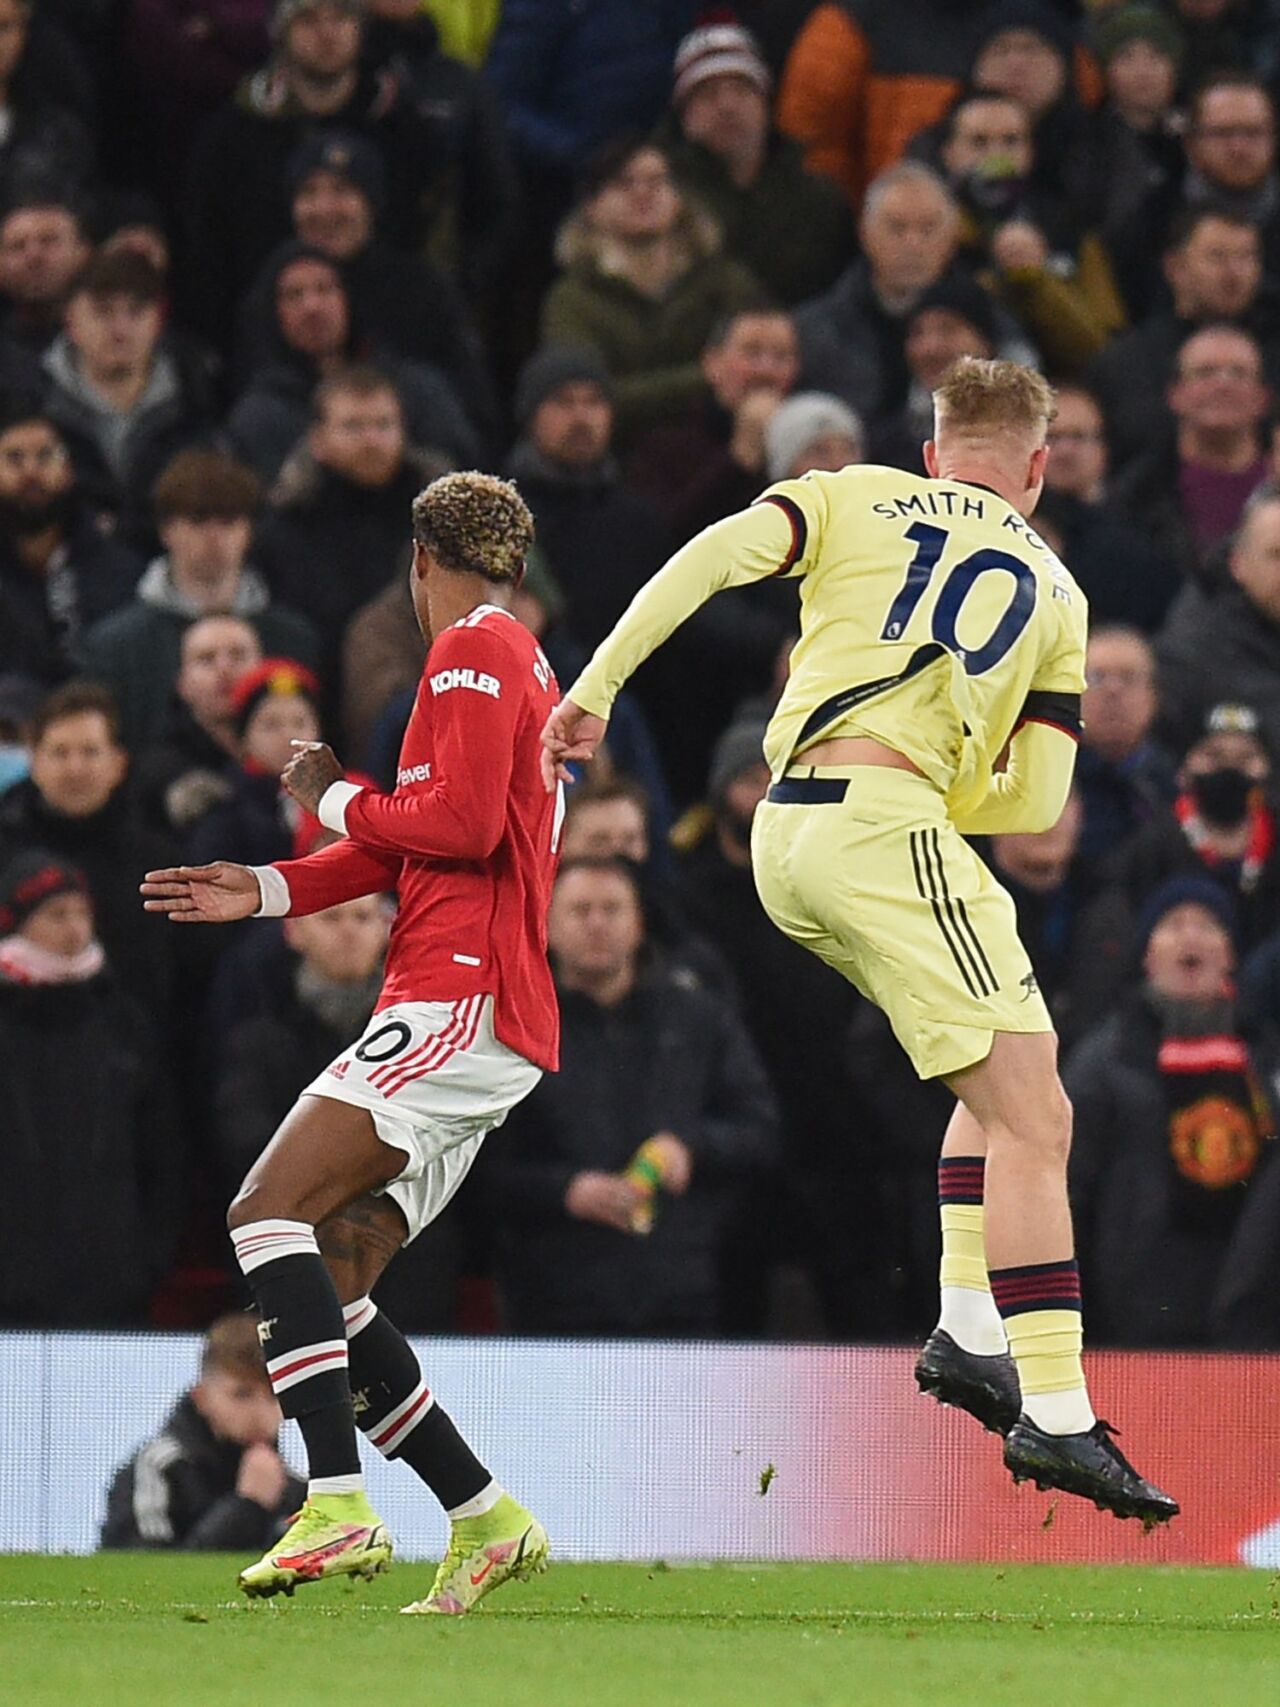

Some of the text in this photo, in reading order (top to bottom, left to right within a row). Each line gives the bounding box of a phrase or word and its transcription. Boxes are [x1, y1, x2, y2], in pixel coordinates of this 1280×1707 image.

[873, 491, 984, 520] SMITH
[879, 520, 1037, 676] 10
[429, 667, 501, 699] KOHLER
[533, 645, 560, 693] RA
